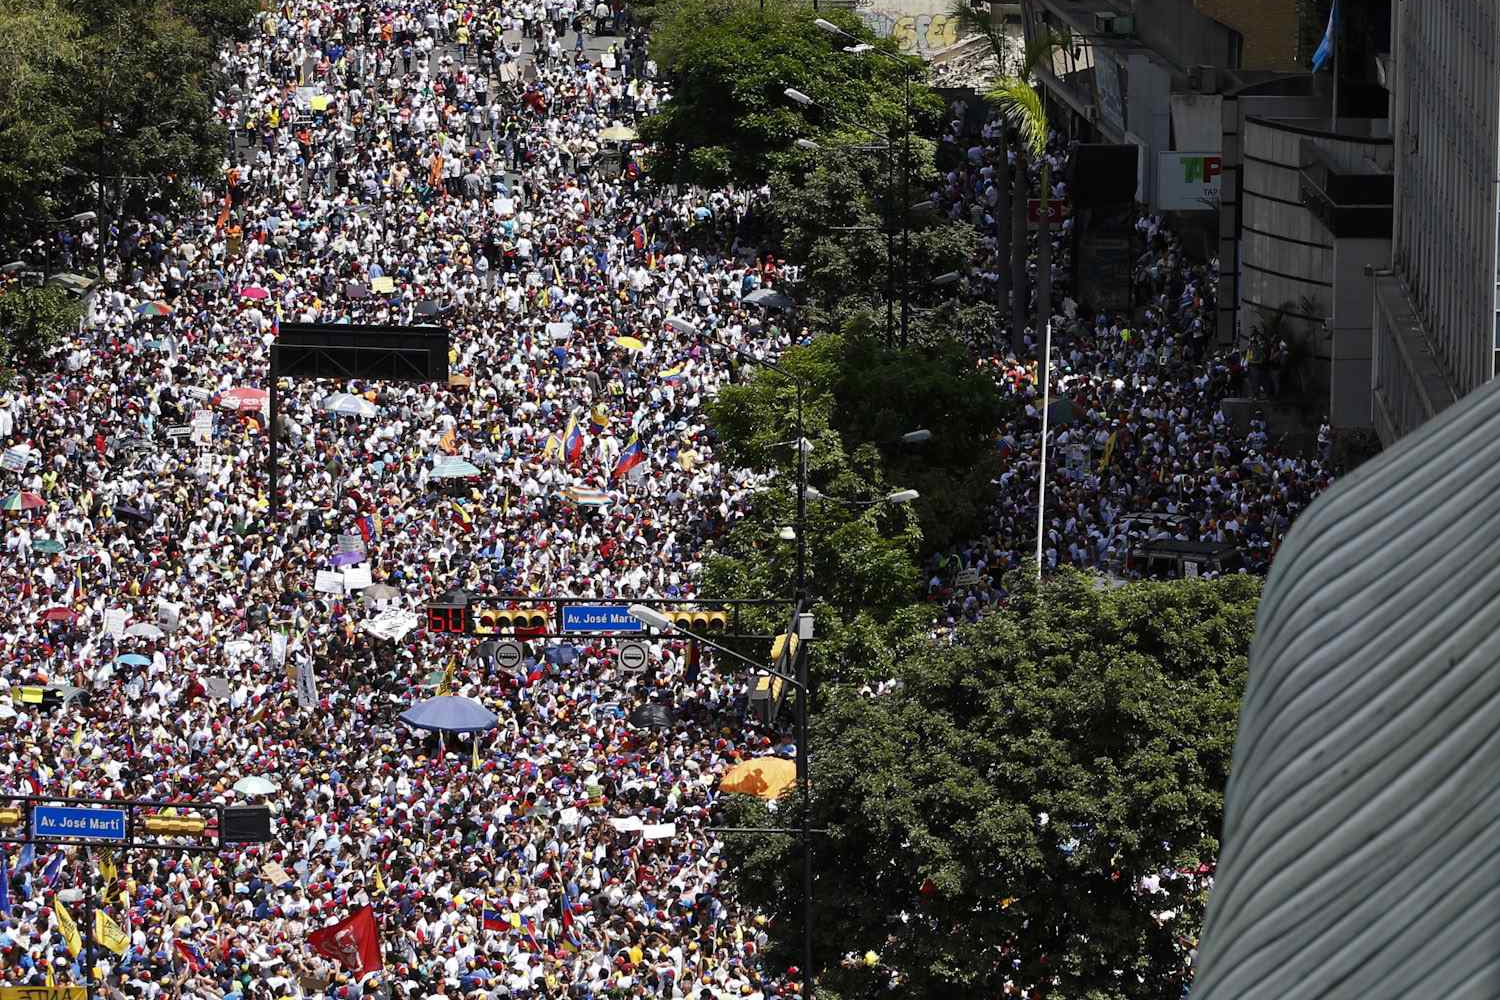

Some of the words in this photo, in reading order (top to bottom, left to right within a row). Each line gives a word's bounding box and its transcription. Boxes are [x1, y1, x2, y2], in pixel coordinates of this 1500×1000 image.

[1181, 157, 1223, 183] TAP
[567, 614, 581, 624] Av.
[583, 613, 608, 624] José
[41, 815, 57, 827] Av.
[60, 816, 87, 829] José
[89, 817, 120, 831] Martí
